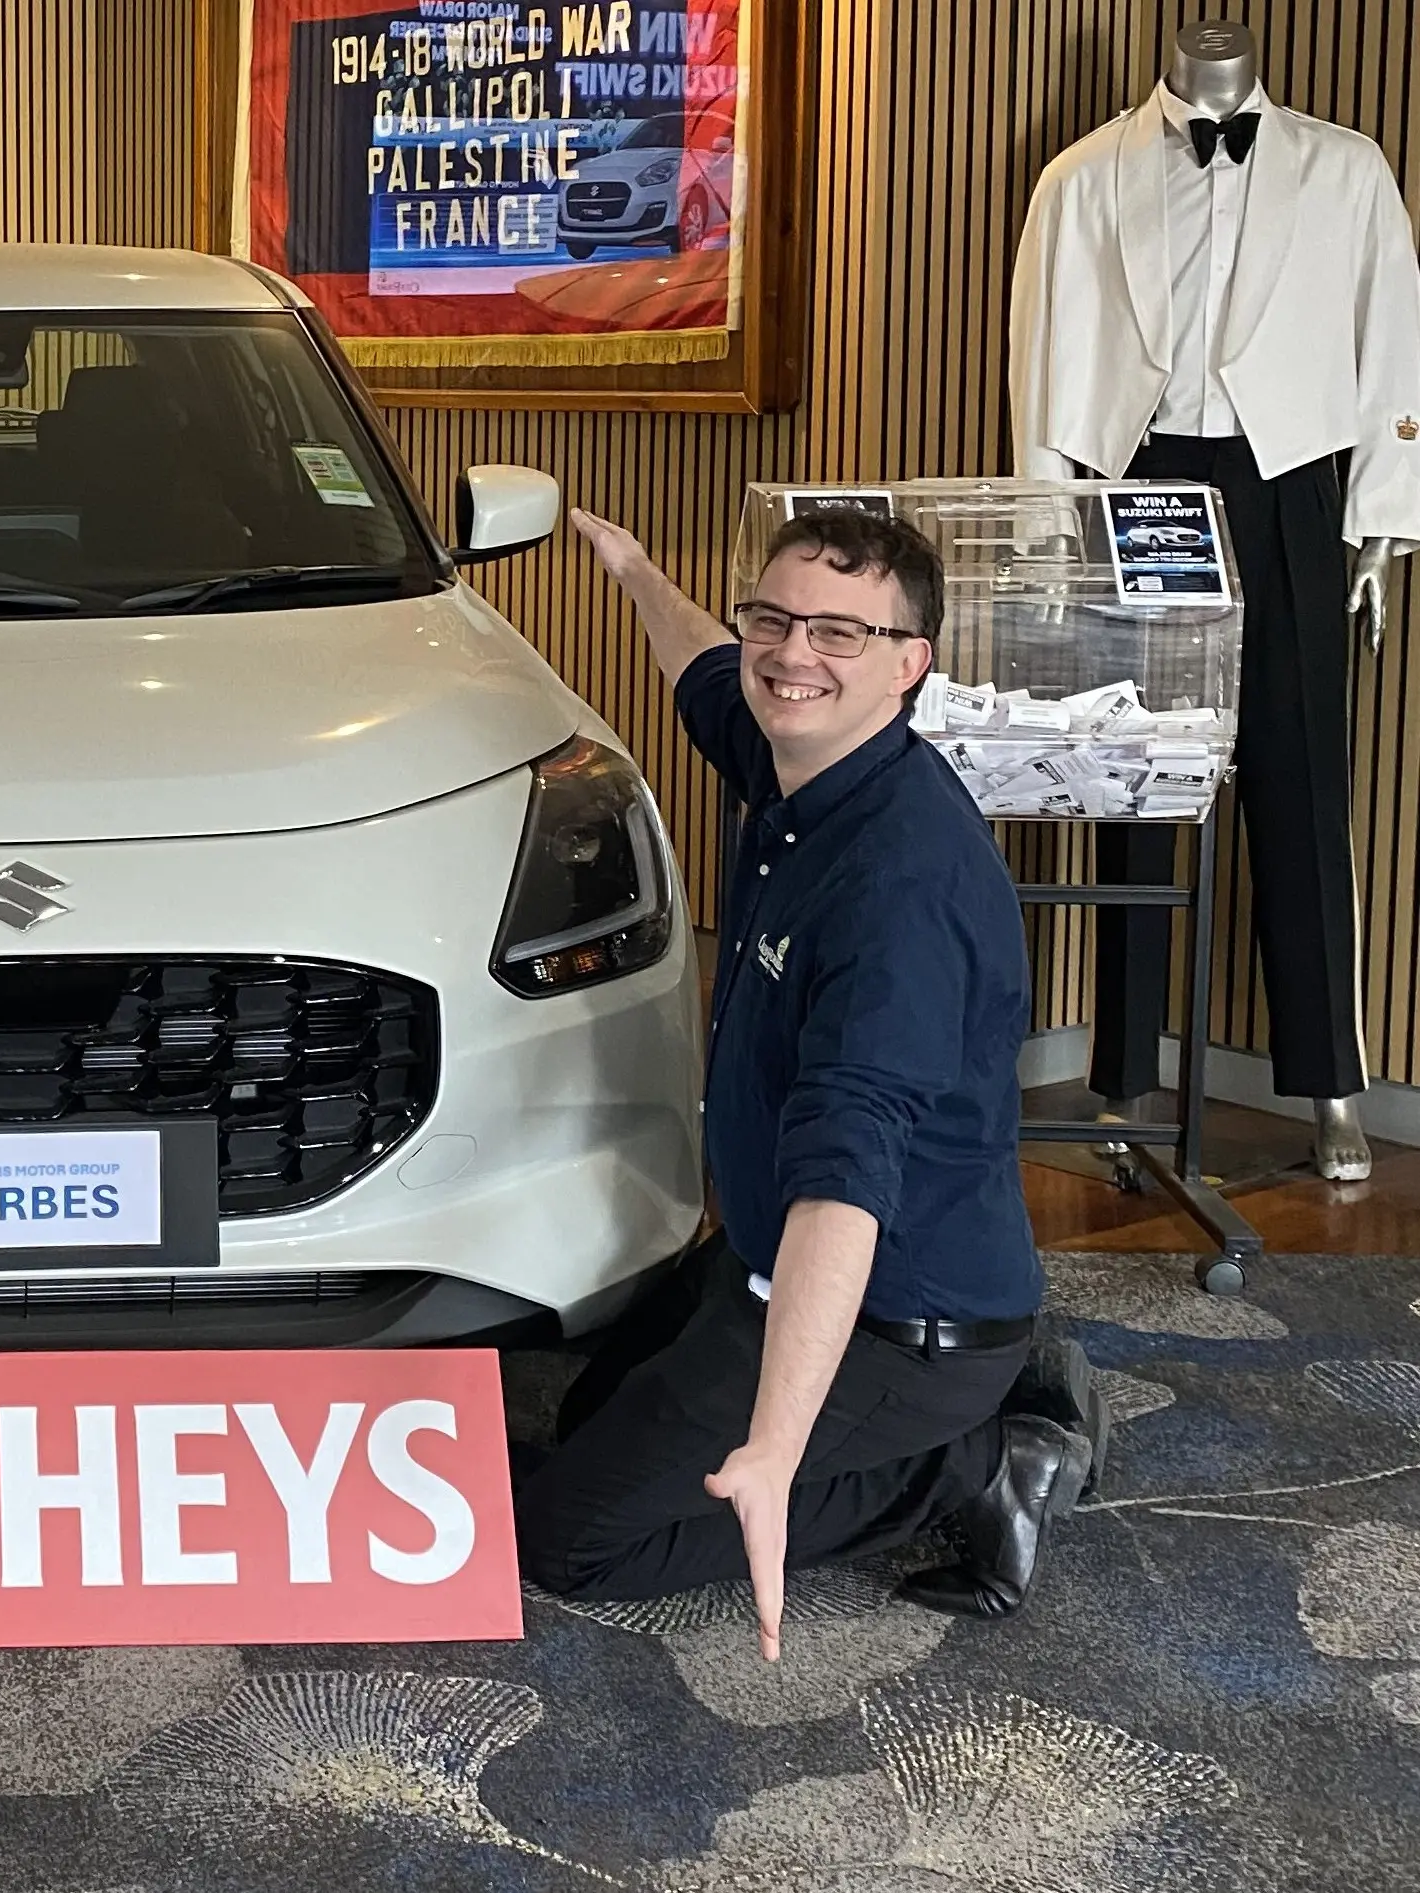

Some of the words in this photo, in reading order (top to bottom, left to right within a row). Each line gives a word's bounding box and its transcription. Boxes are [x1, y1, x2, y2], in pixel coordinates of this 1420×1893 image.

[446, 8, 546, 72] WORLD
[561, 0, 631, 57] WAR
[375, 68, 573, 137] GALLIPOLI
[367, 128, 580, 194] PALESTINE
[395, 194, 542, 251] FRANCE
[1117, 507, 1162, 517] SUZUKI
[1164, 507, 1203, 517] SWIFT
[1132, 496, 1166, 508] WIN
[1169, 496, 1183, 508] A
[14, 1164, 67, 1177] MOTOR
[69, 1162, 121, 1176] GROUP
